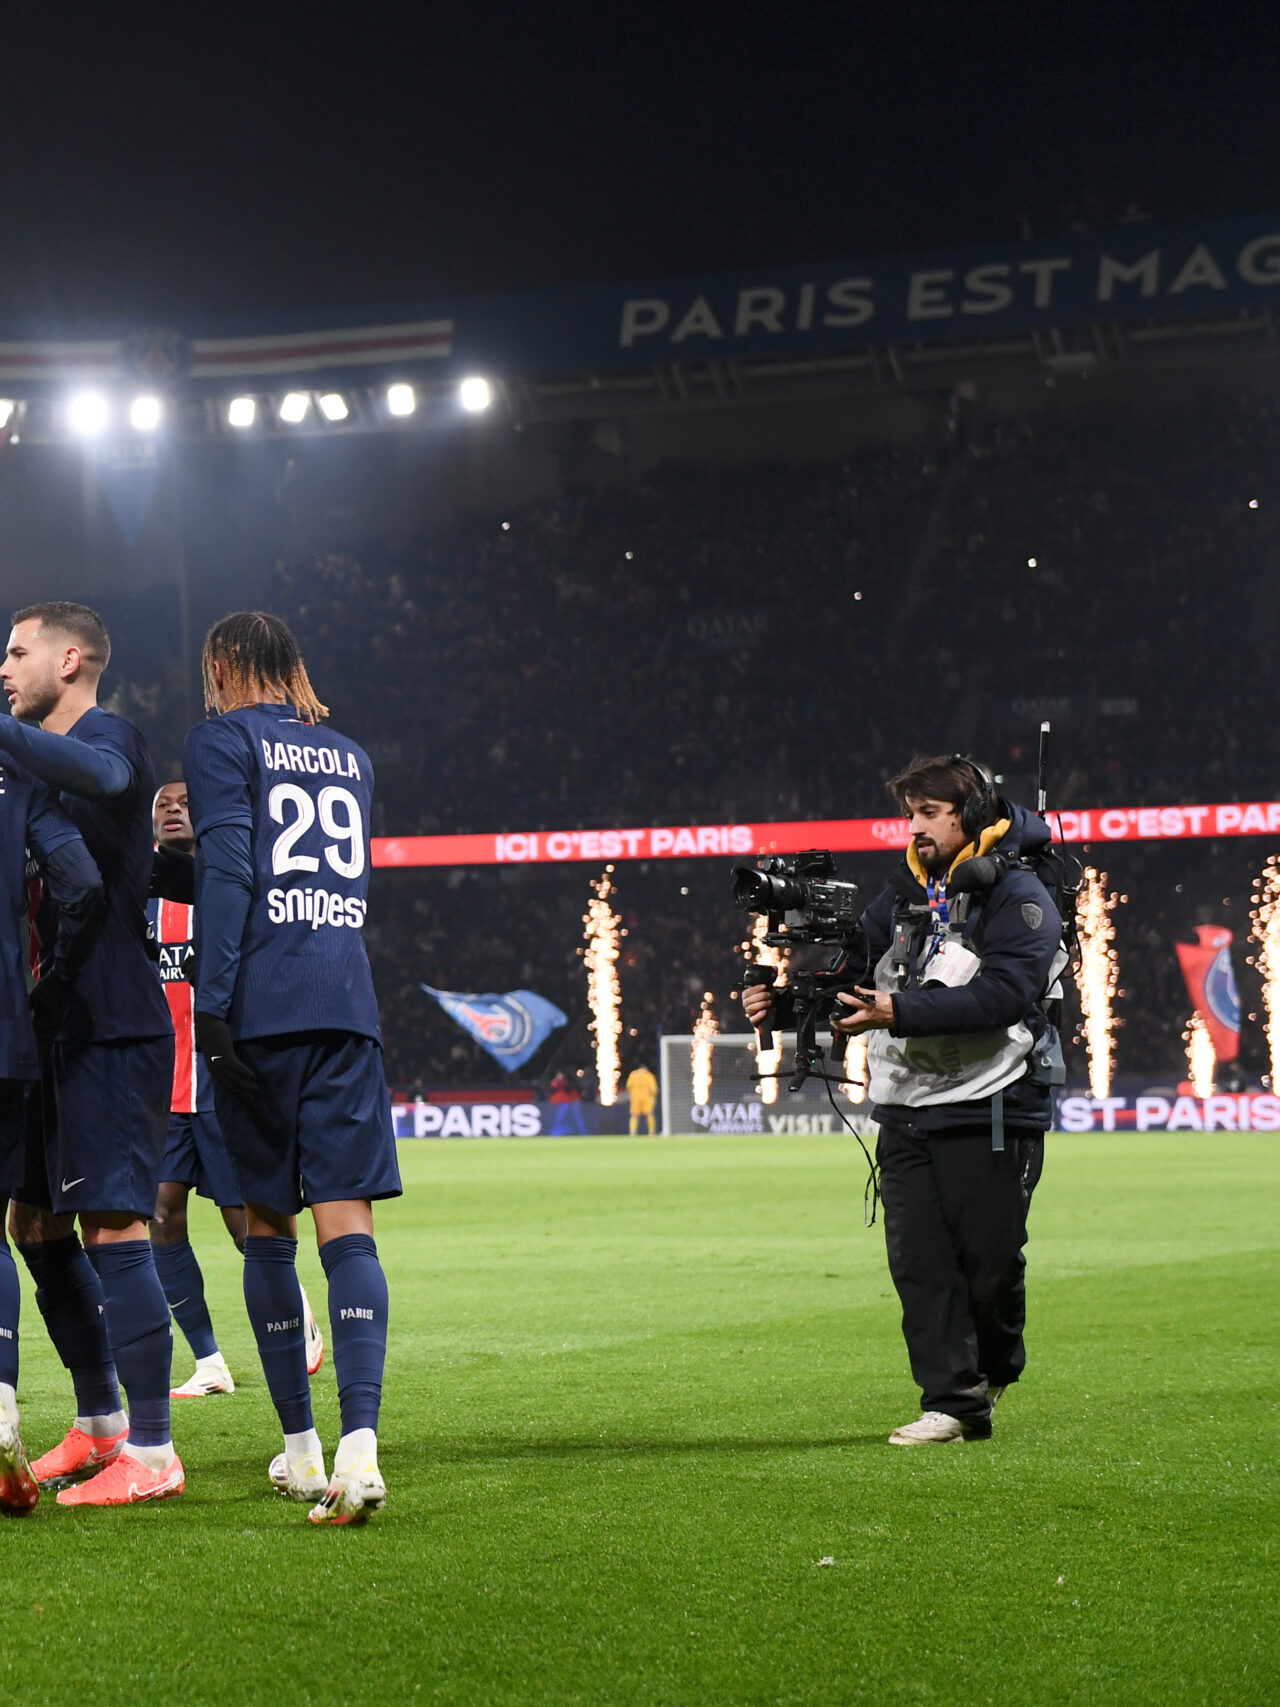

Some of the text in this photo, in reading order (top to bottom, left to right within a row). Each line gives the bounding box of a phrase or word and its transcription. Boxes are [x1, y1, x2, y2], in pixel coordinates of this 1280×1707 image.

[620, 278, 875, 347] PARIS
[906, 258, 1071, 320] EST
[262, 738, 361, 781] BARCOLA
[269, 783, 365, 879] 29
[1099, 806, 1209, 839] C'EST
[495, 825, 753, 861] ICI C'EST PARIS
[268, 887, 365, 931] snipes
[414, 1104, 542, 1138] PARIS
[691, 1102, 762, 1127] QATAR
[768, 1114, 834, 1135] VISIT
[1136, 1095, 1280, 1132] PARIS
[267, 1317, 299, 1333] PARIS
[339, 1307, 373, 1320] PARIS
